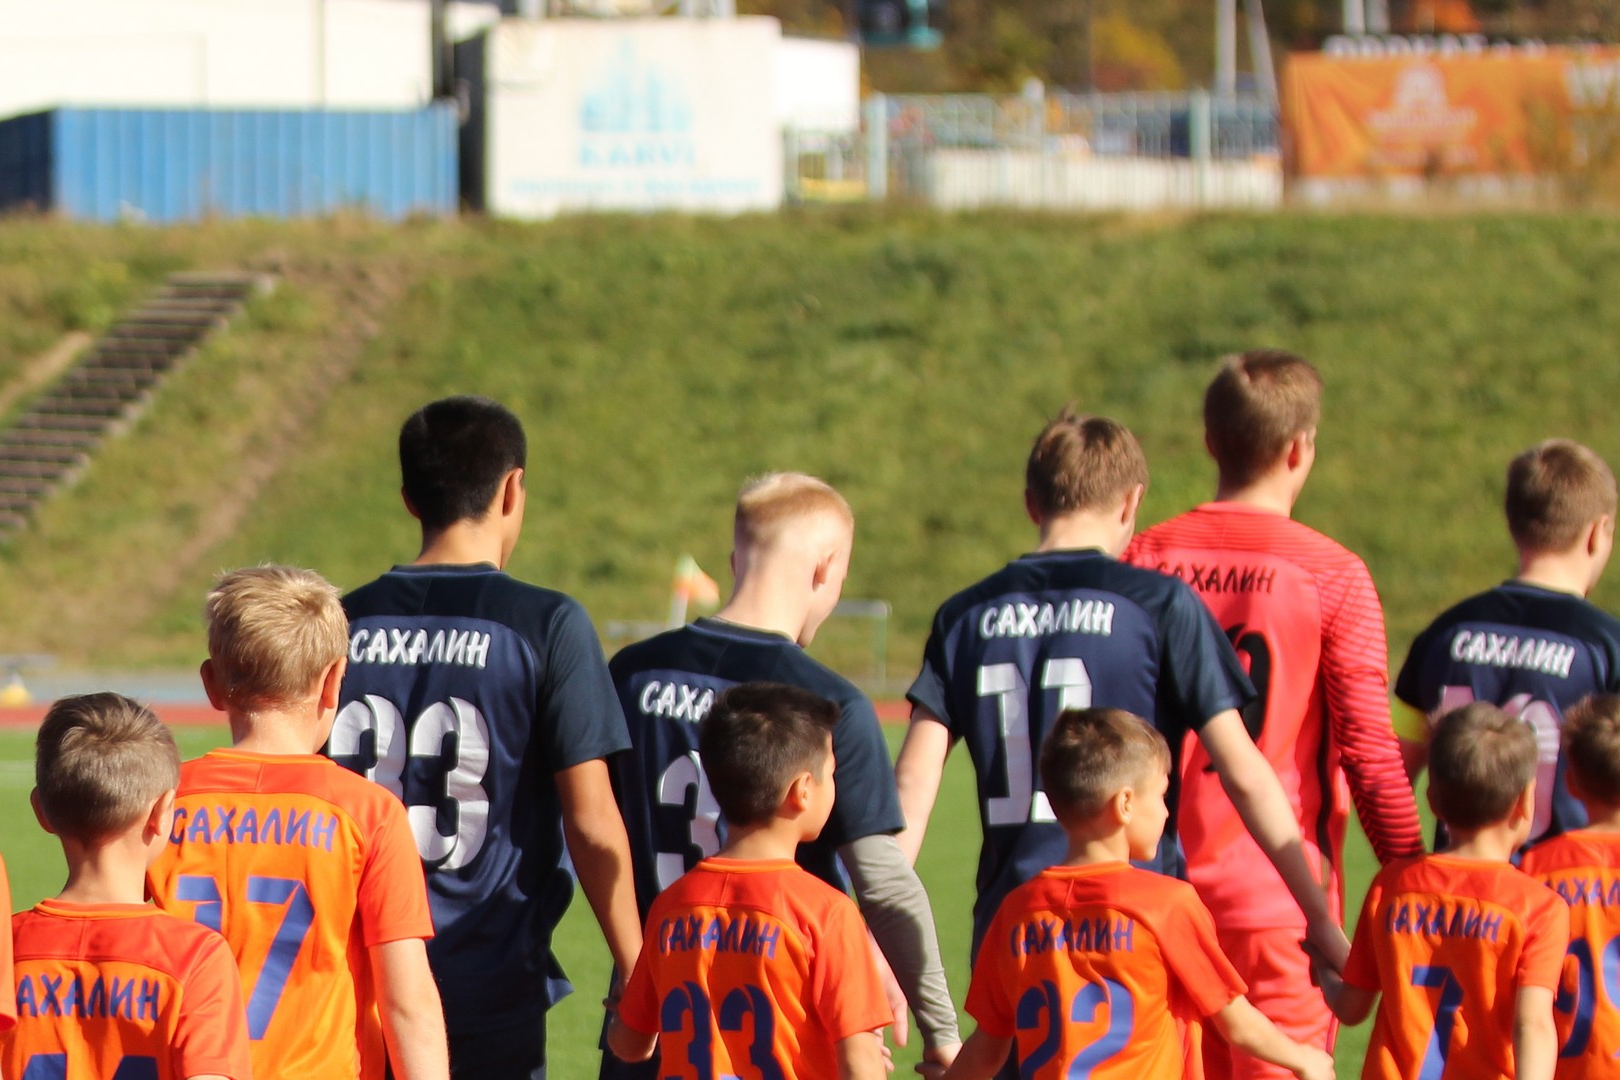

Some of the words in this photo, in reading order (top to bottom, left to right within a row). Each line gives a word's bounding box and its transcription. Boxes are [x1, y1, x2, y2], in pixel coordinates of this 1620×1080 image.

[980, 599, 1116, 638] САХАЛИН
[350, 627, 492, 669] САХАЛИН
[1453, 630, 1576, 679] САХАЛИН
[170, 806, 337, 853] САХАЛИН
[659, 917, 780, 960] САХАЛИН
[1011, 918, 1135, 957] САХАЛИН
[1386, 902, 1503, 943] САХАЛИН
